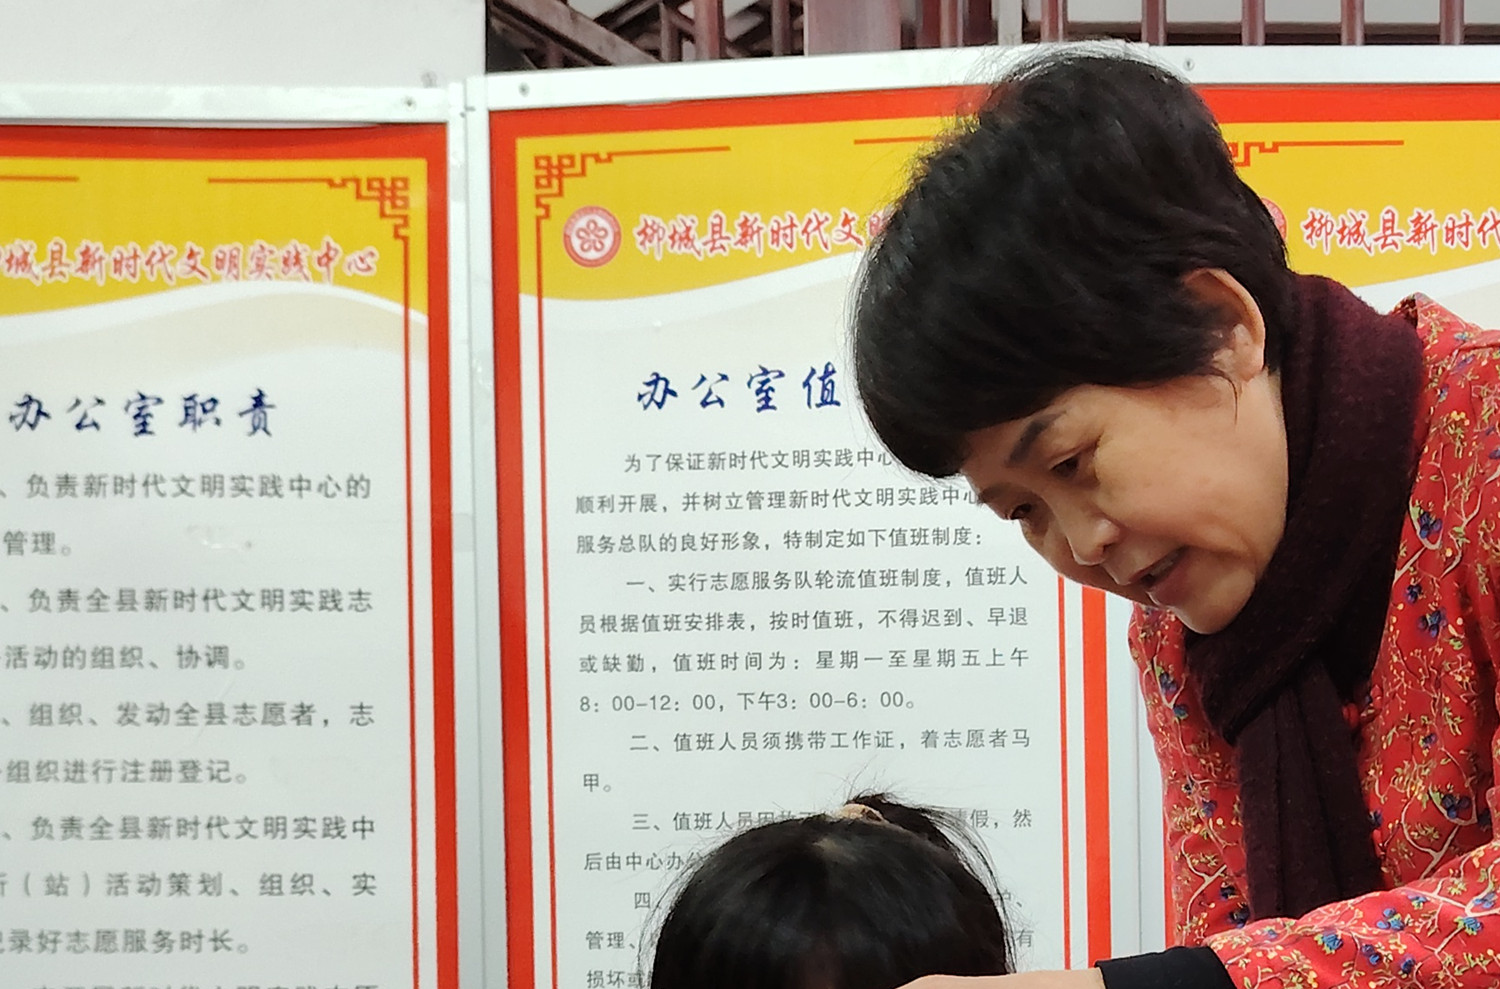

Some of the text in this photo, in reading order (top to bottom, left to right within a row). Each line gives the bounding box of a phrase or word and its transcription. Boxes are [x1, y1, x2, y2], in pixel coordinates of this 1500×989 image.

[0, 243, 376, 282] 城县新时代文明实践中心
[8, 388, 277, 437] 办公室职责
[576, 525, 982, 554] 服务总队的良好形象，特制定如下值班制度：
[626, 565, 1028, 592] 一、实行志愿服务队轮流值班制度，值班人
[580, 606, 1028, 634] 员根据值班安排表，按时值班，不得迟到、早退
[580, 647, 1030, 674] 或缺勤，值班时间为：星期一至星期五上午
[630, 729, 1030, 754] 二、值班人员须携带工作证，着志愿者马
[583, 774, 612, 793] 甲。
[0, 928, 249, 955] 录好志愿服务时长。
